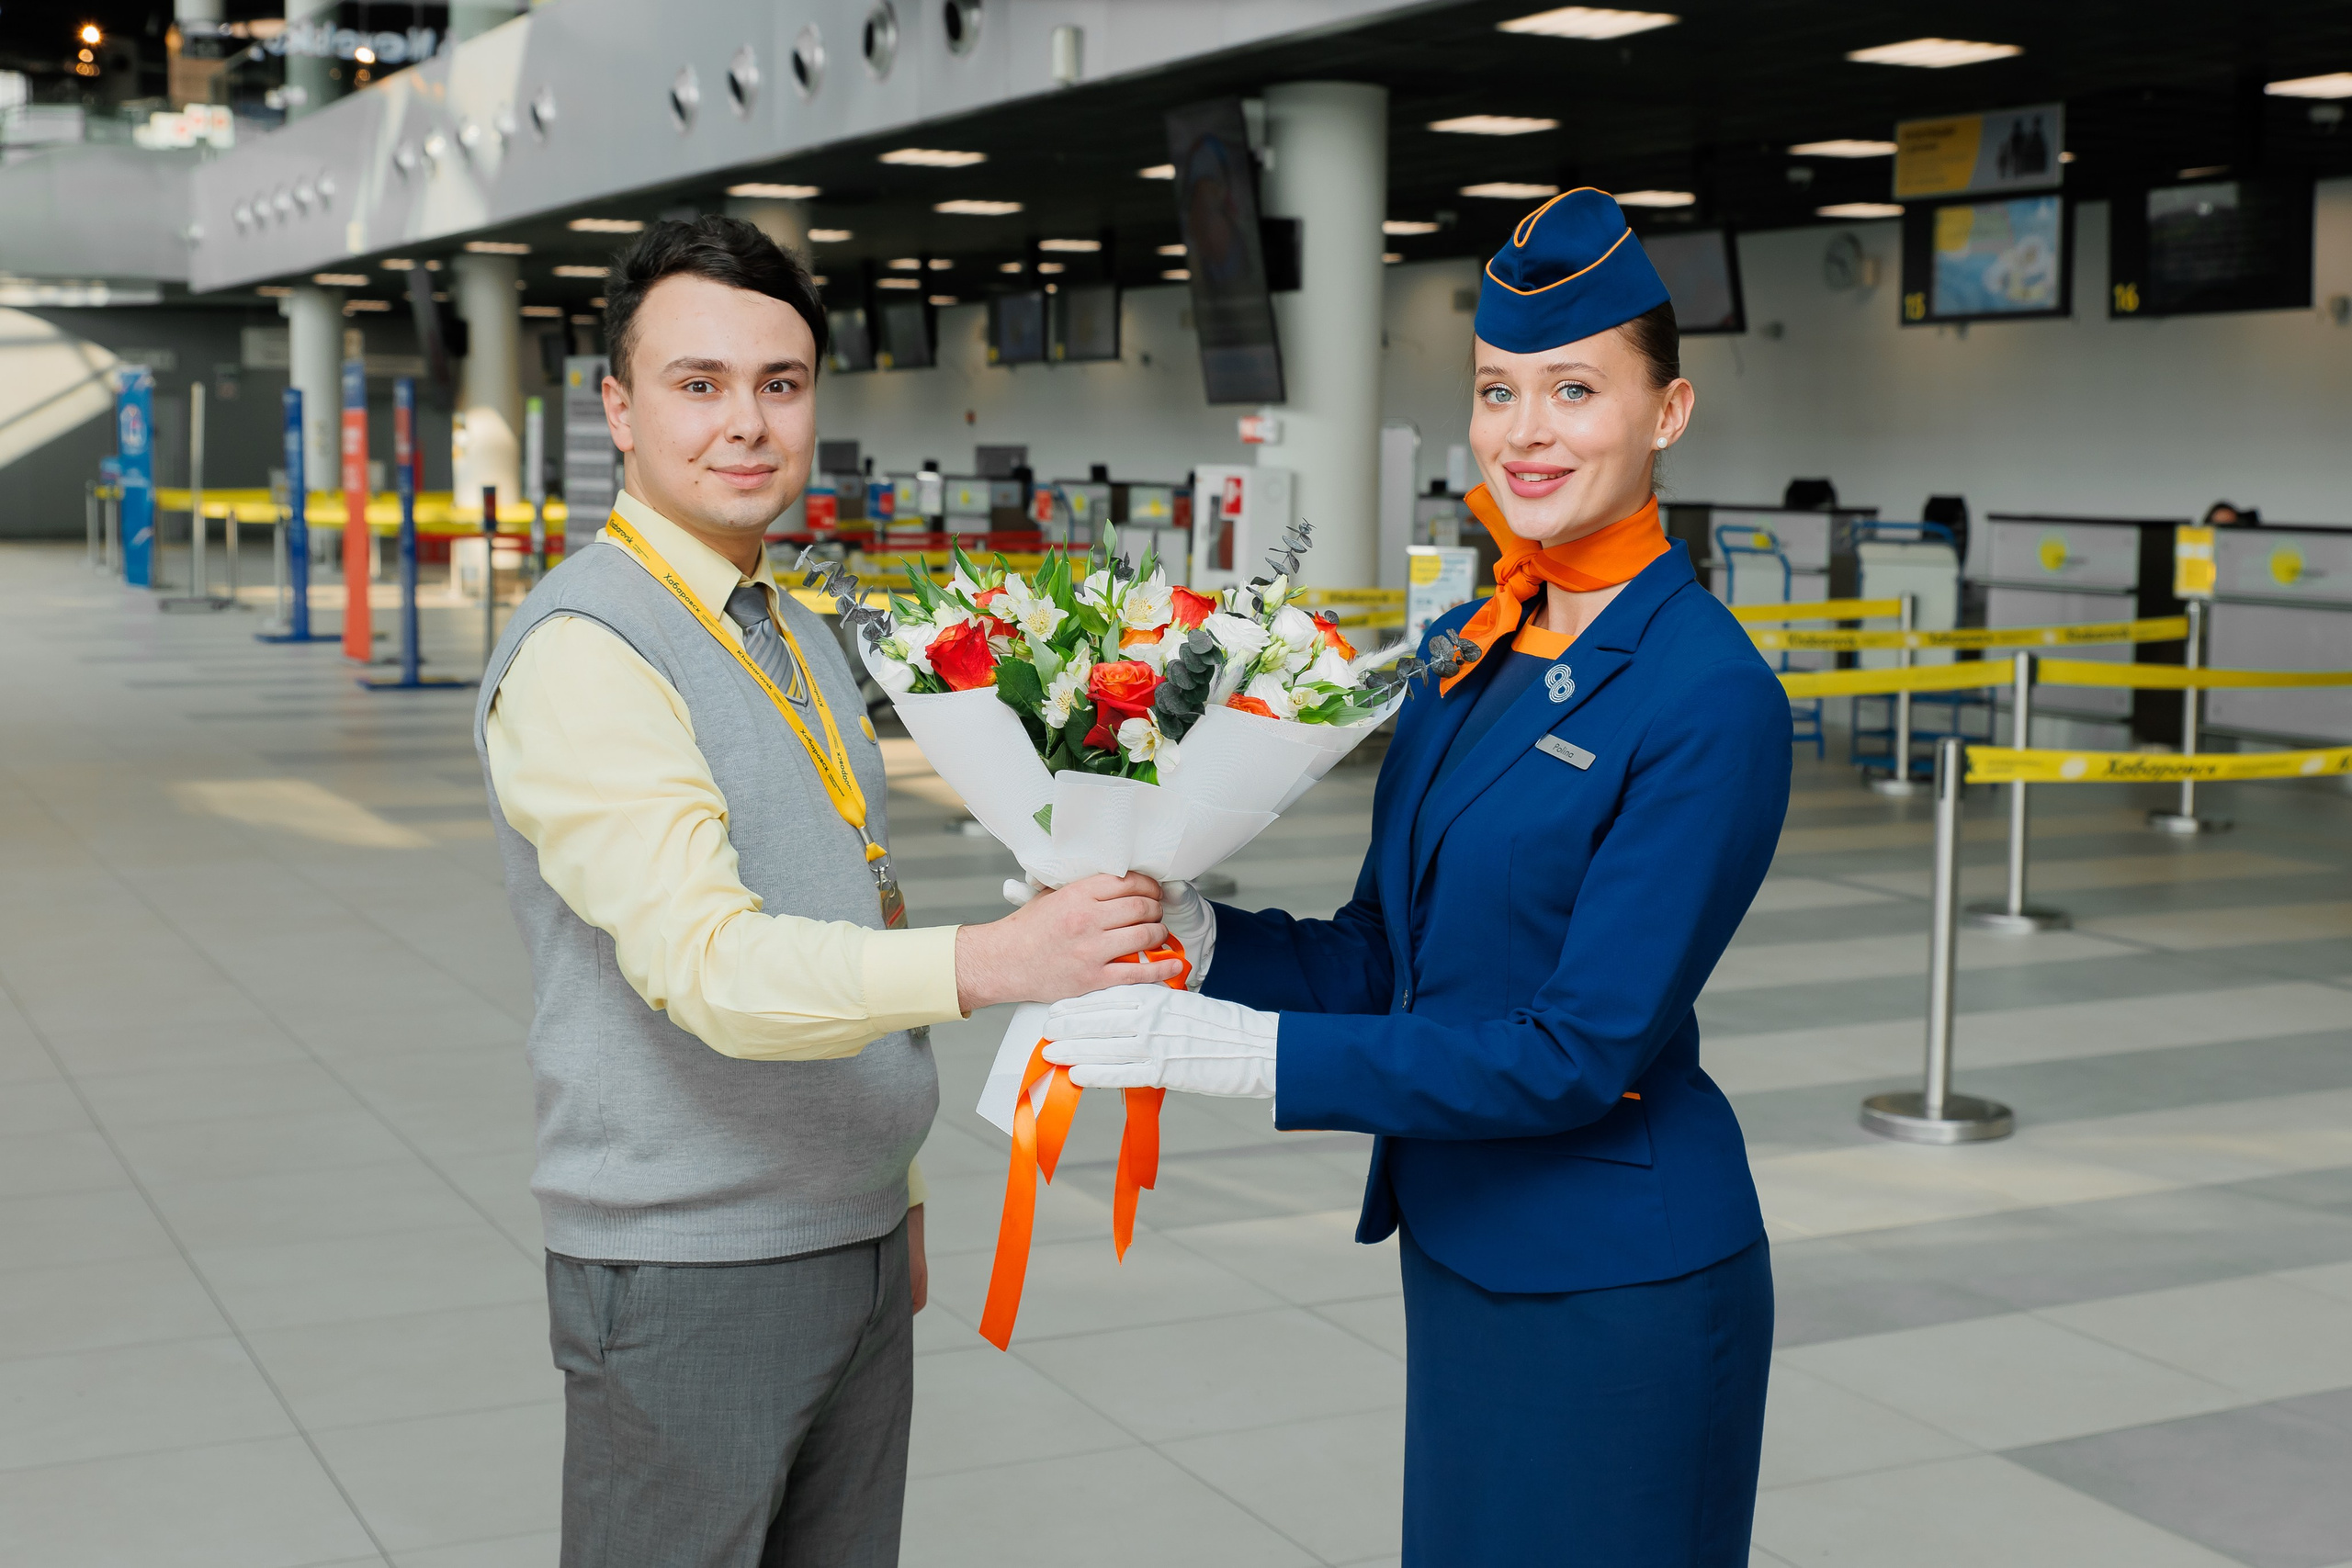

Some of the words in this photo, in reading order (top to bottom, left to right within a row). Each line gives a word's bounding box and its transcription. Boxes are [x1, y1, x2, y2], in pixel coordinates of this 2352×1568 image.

[663, 572, 701, 614] Хабаровск
[737, 649, 773, 691] Khabarovsk
[799, 728, 830, 773] Хабаровск
[1552, 742, 1575, 759] Polina
